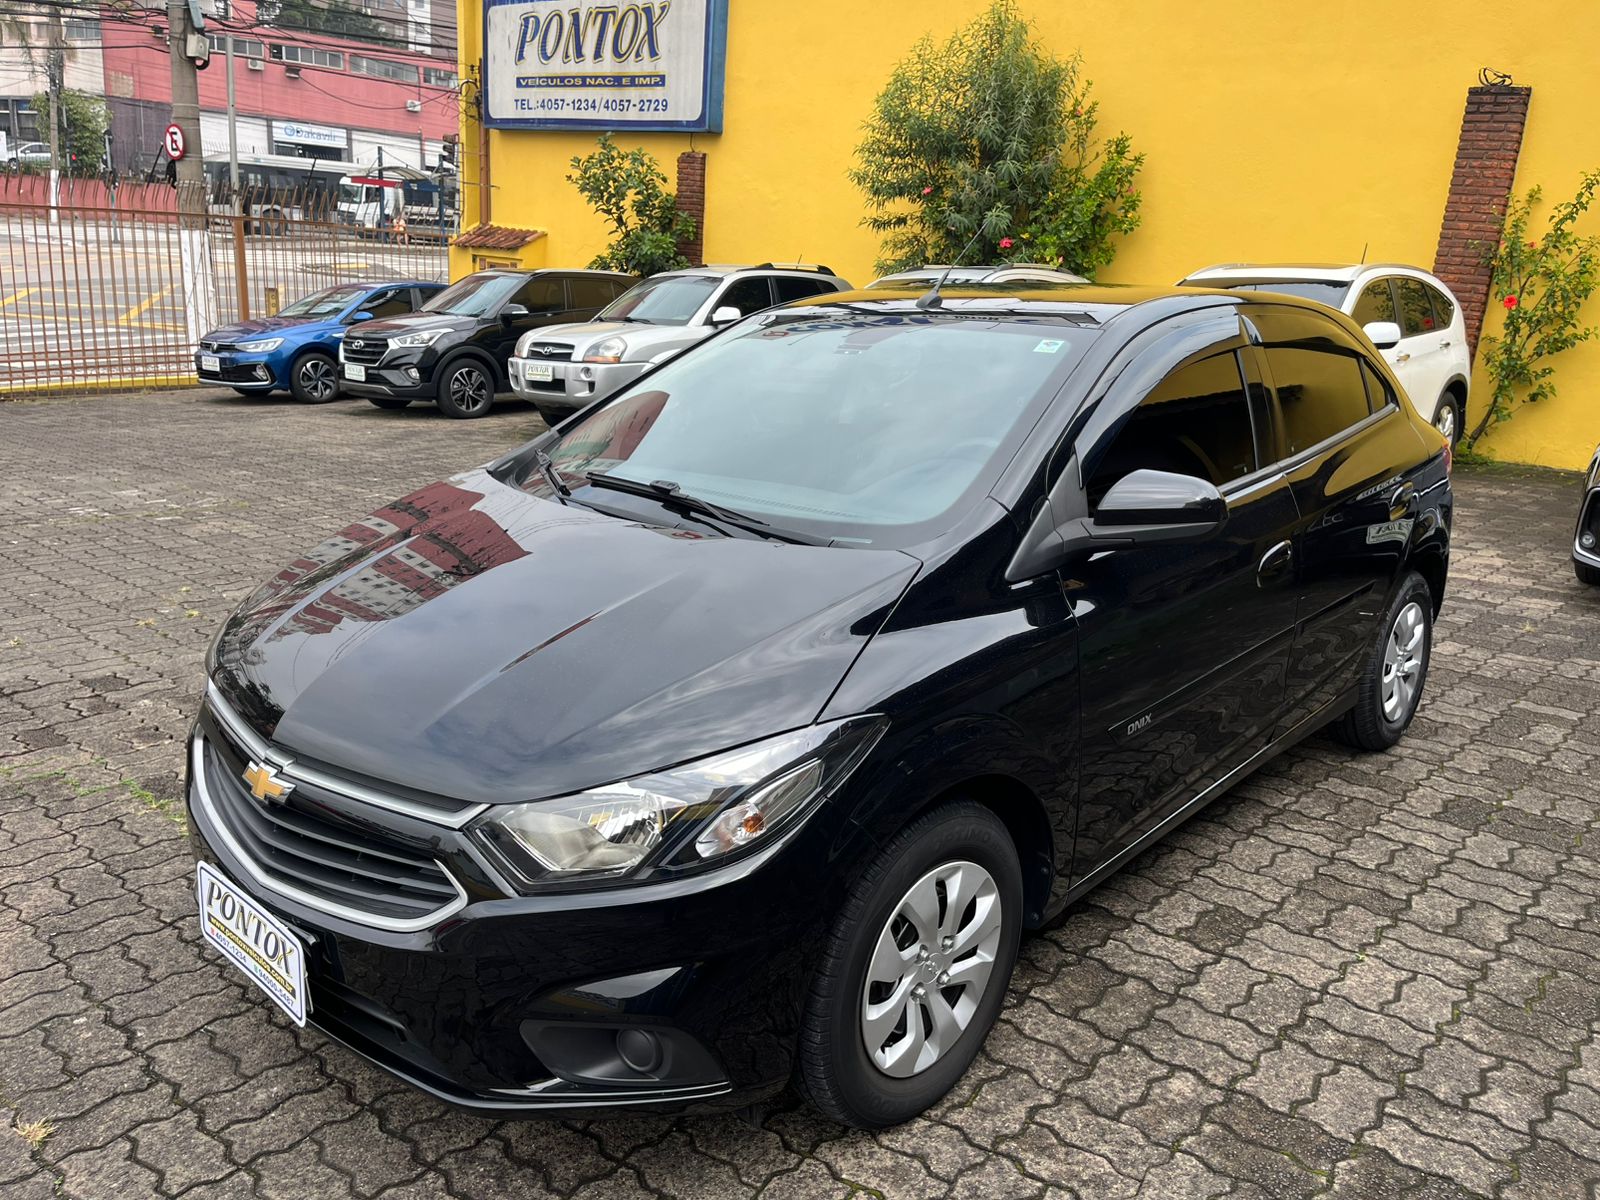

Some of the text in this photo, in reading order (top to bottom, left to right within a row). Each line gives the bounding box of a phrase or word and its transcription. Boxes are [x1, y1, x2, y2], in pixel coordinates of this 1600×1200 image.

[515, 1, 670, 64] PONTOX
[586, 77, 618, 86] NAC.
[622, 77, 631, 85] E
[634, 76, 663, 85] IMP.
[1127, 713, 1152, 736] ONIX
[207, 879, 294, 979] PONTOX
[210, 916, 294, 993] www.pontoxveiculos.com.br
